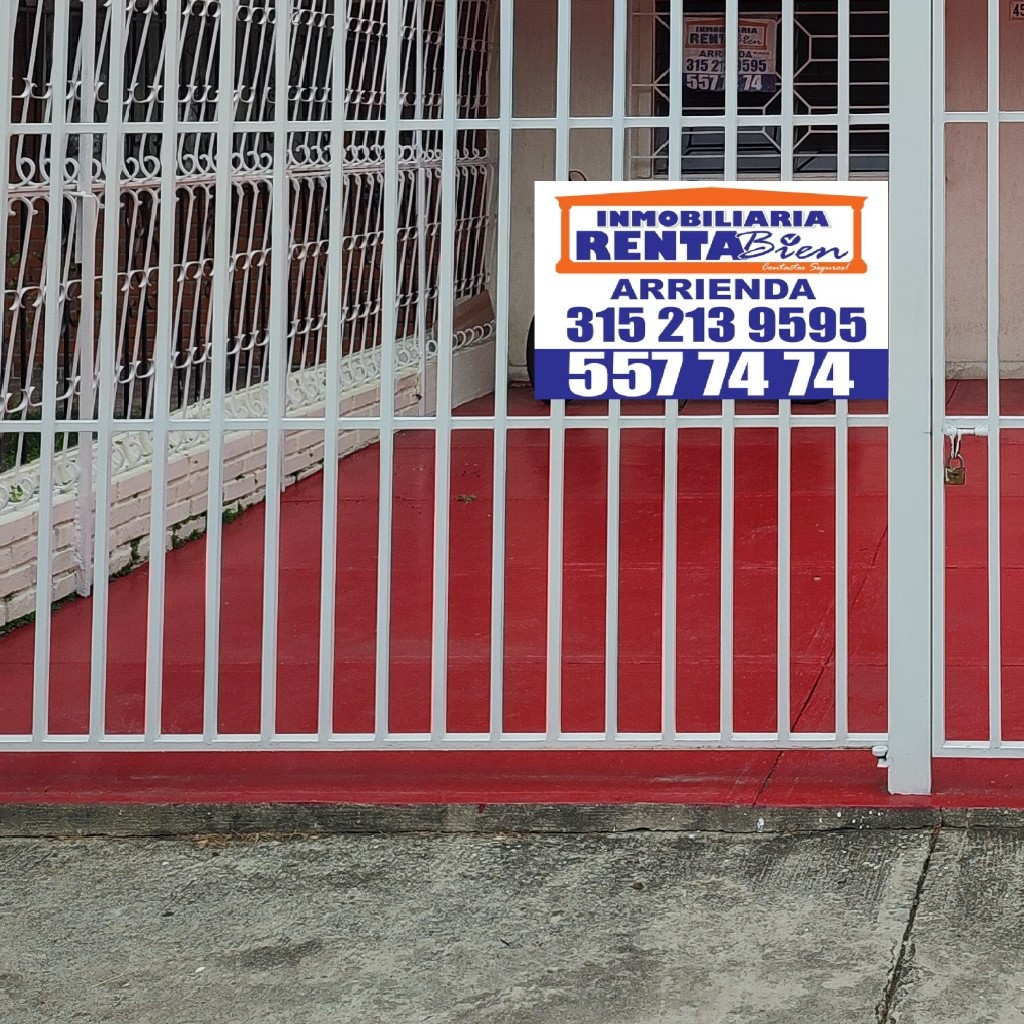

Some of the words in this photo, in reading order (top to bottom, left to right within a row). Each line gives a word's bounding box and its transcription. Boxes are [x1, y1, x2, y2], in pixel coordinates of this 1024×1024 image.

[686, 58, 708, 72] 315
[686, 74, 719, 90] 557
[742, 74, 763, 91] 74
[597, 210, 831, 227] INMOBILIARIA
[610, 278, 816, 300] ARRIENDA
[566, 306, 646, 343] 315
[657, 306, 735, 343] 213
[748, 306, 867, 343] 9595
[568, 351, 684, 397] 557
[697, 351, 769, 396] 74
[783, 351, 855, 396] 74
